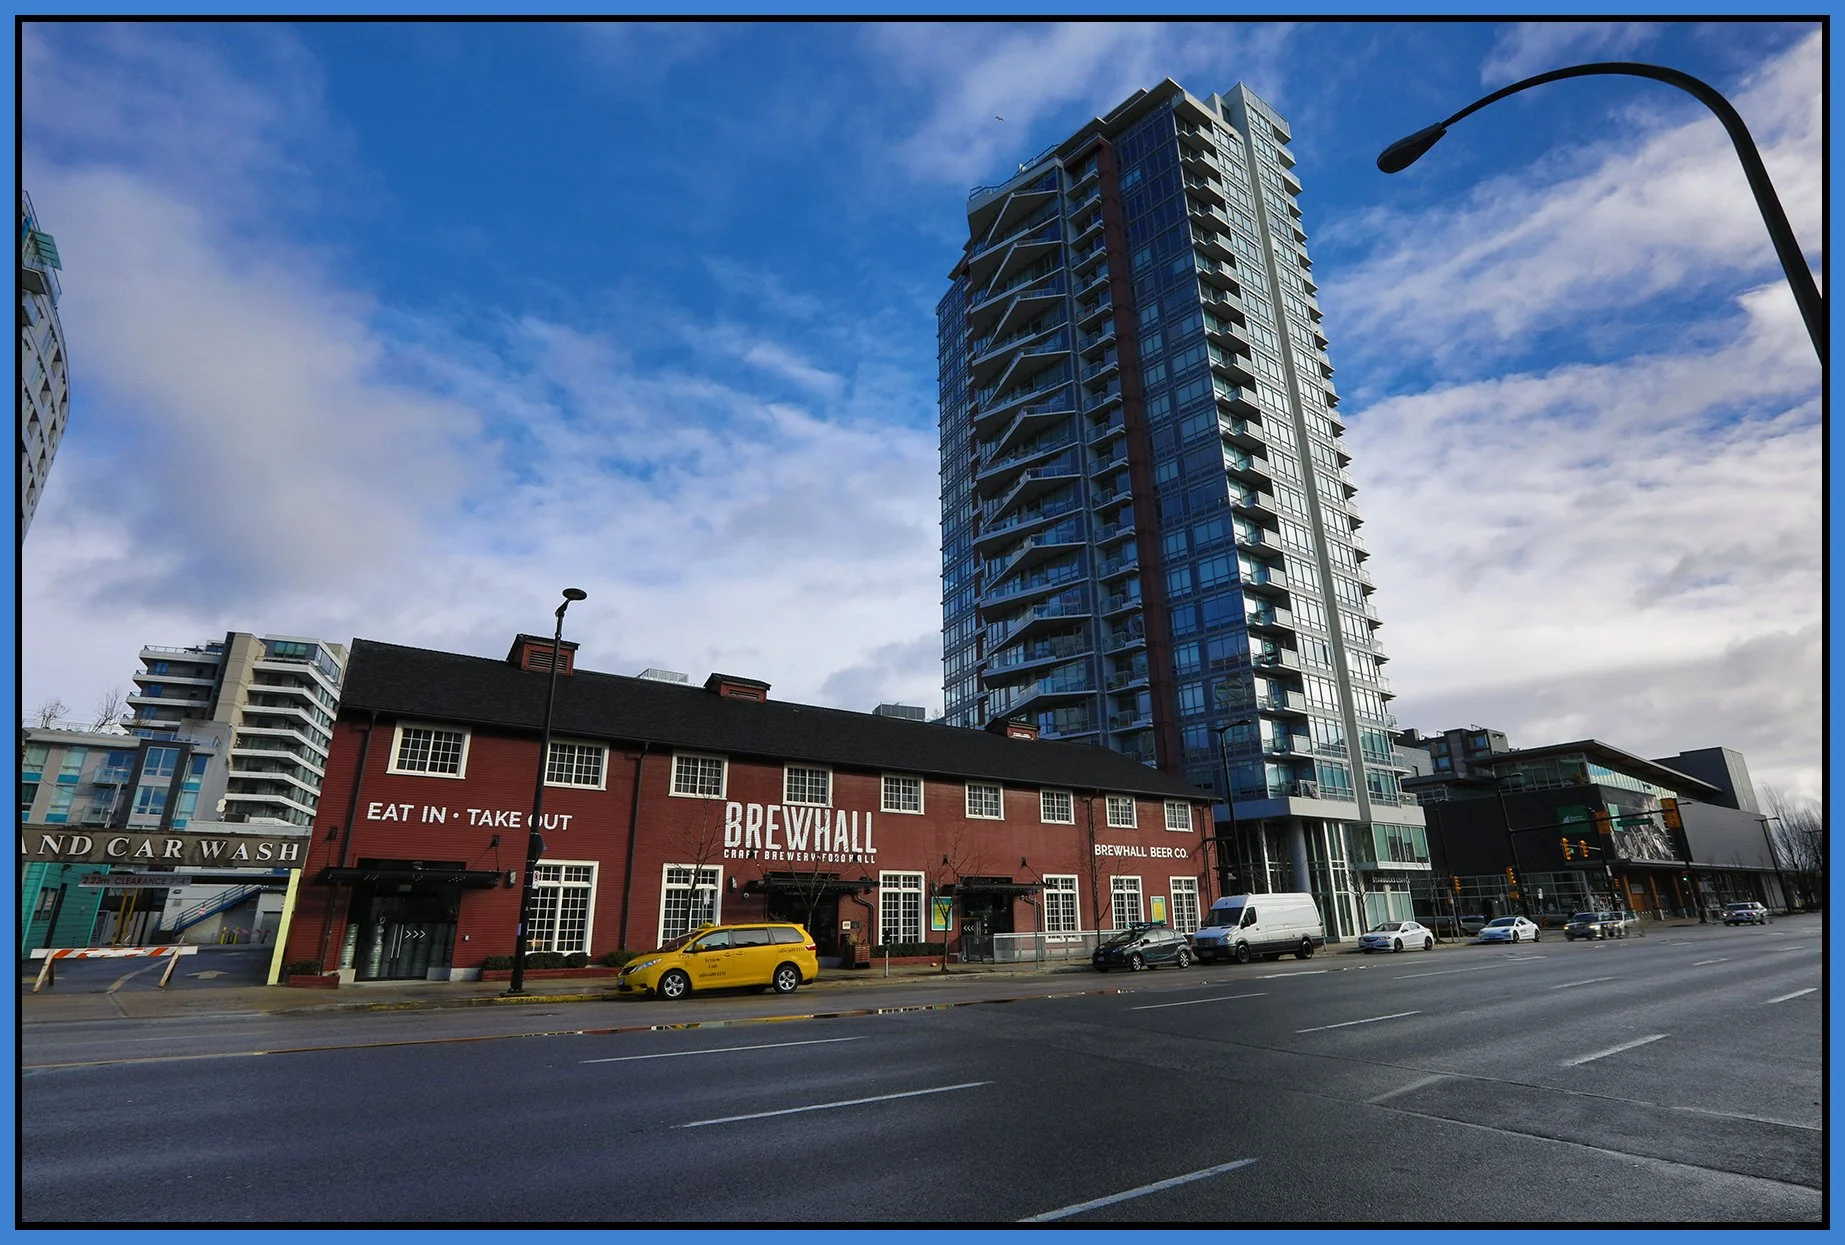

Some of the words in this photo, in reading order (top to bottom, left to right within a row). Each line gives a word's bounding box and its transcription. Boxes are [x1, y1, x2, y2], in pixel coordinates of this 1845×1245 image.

[367, 802, 415, 822] EAT
[421, 805, 447, 824] IN
[466, 808, 522, 828] TAKE
[724, 801, 877, 854] BREWHALL
[22, 834, 93, 855] ND
[107, 837, 183, 858] CAR
[200, 840, 299, 861] WASH
[723, 849, 759, 859] CRAFT
[764, 850, 815, 862] BREWERY
[1094, 844, 1147, 857] BREWHALL
[1150, 846, 1173, 858] BEER
[1174, 848, 1189, 859] CO.
[115, 877, 166, 886] CLEARANCE
